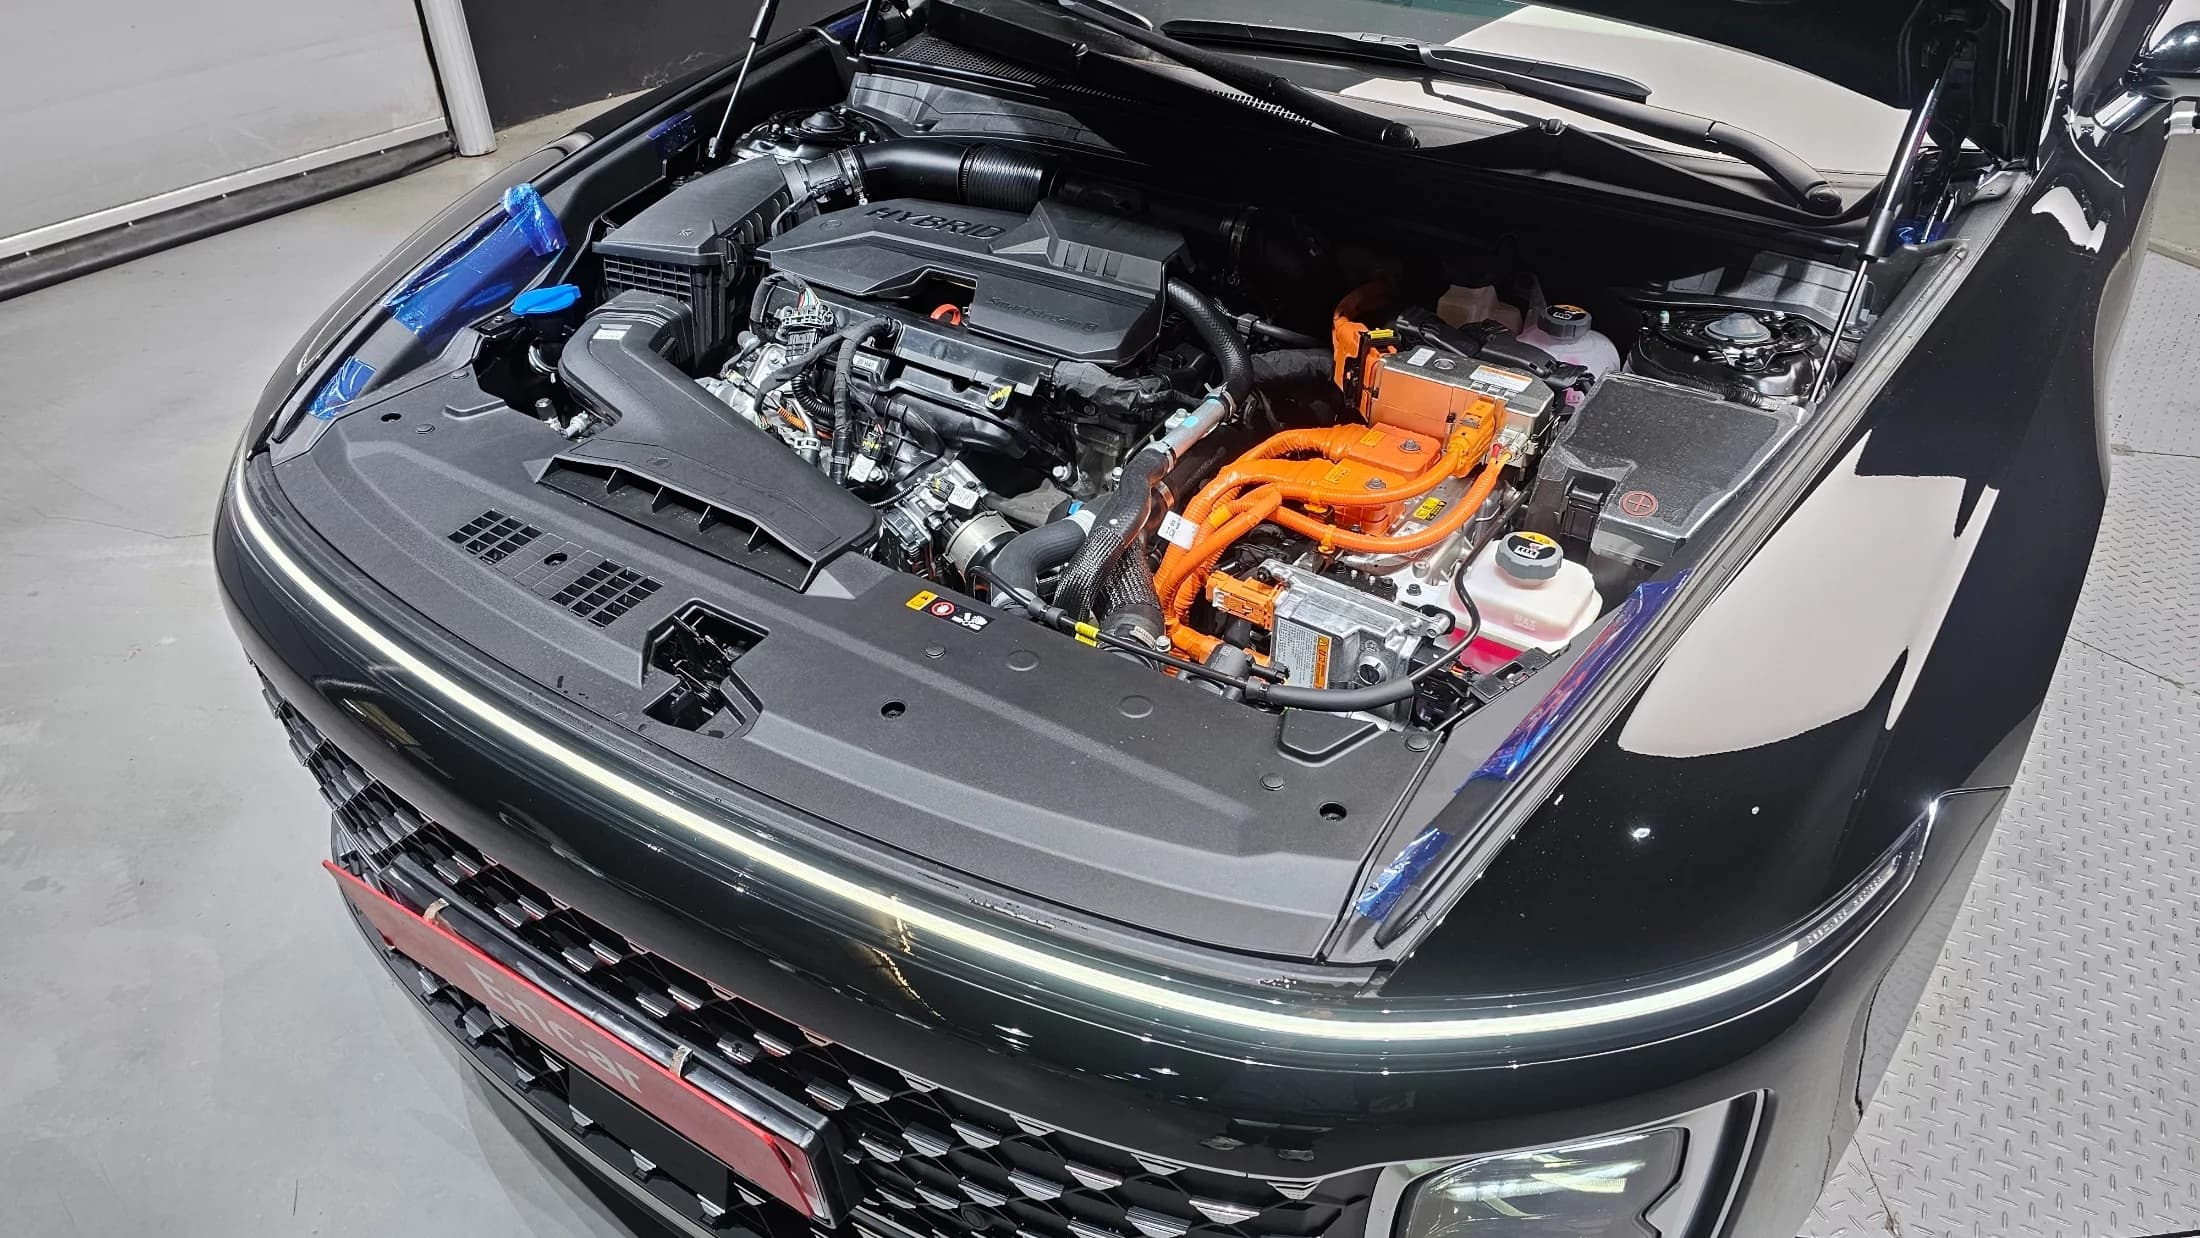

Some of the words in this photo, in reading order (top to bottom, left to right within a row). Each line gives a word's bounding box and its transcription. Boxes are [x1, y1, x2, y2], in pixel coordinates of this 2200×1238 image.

[864, 207, 1006, 240] HYBRID
[984, 297, 1081, 329] Smartstream
[465, 962, 641, 1093] Encar
